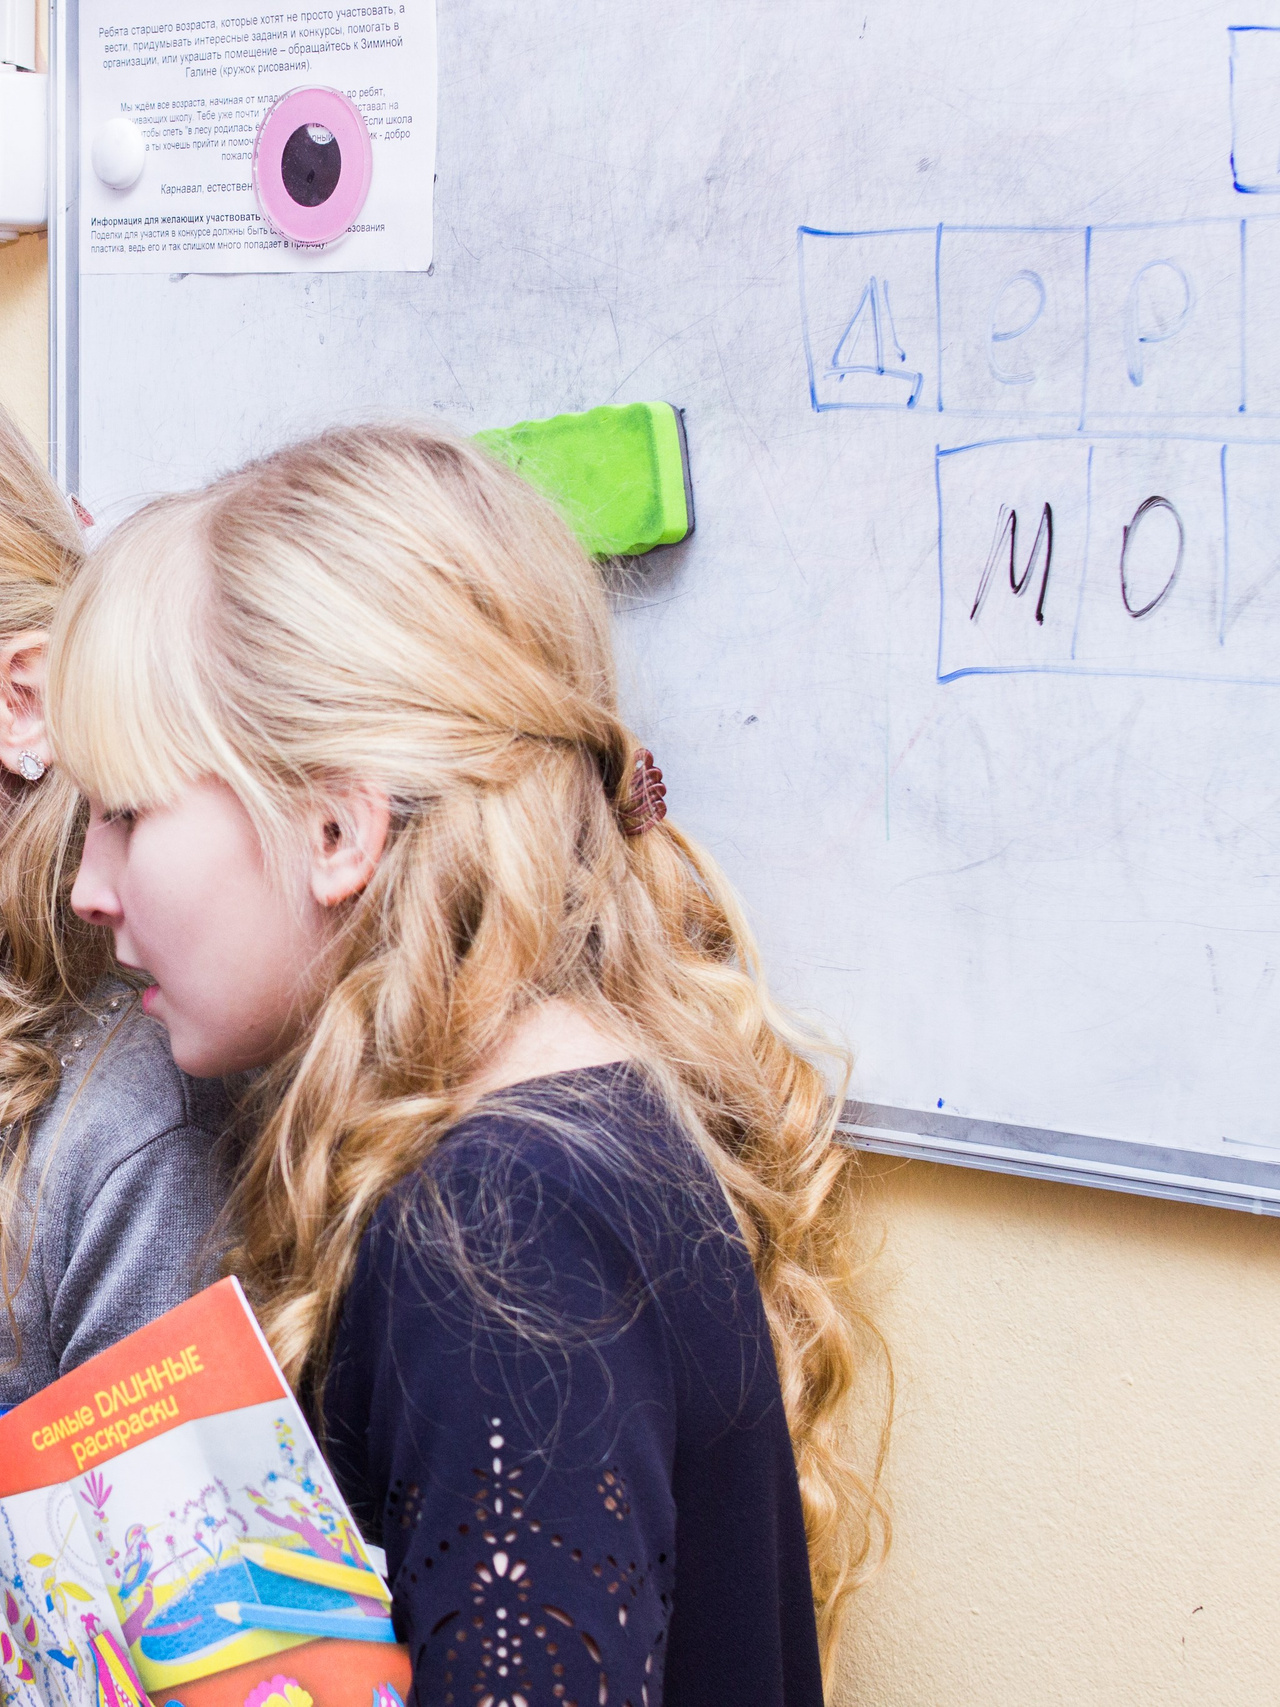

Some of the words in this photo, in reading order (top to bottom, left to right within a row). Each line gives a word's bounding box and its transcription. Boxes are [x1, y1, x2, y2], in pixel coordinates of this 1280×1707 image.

[99, 26, 128, 38] Ребята
[131, 23, 173, 36] старшего
[221, 16, 258, 29] которые
[261, 13, 284, 24] хотят
[287, 12, 298, 22] не
[301, 10, 333, 23] просто
[399, 5, 405, 14] а
[133, 37, 192, 52] придумывать
[194, 33, 249, 47] интересные
[251, 30, 288, 42] задания
[290, 29, 297, 38] и
[348, 22, 391, 35] помогать
[393, 22, 400, 31] в
[162, 54, 178, 64] или
[180, 51, 222, 66] украшать
[224, 47, 277, 60] помещение
[288, 41, 351, 55] обращайтесь
[353, 40, 359, 50] к
[361, 36, 403, 50] Зиминой
[185, 66, 217, 78] Галине
[220, 64, 255, 78] (кружок
[120, 102, 133, 112] Мы
[157, 101, 170, 110] все
[210, 96, 243, 106] начиная
[246, 95, 255, 104] от
[347, 90, 357, 99] до
[197, 110, 215, 121] Тебе
[218, 109, 233, 120] уже
[235, 108, 260, 119] почти
[389, 101, 399, 110] на
[162, 127, 183, 138] спеть
[194, 124, 211, 136] лесу
[214, 122, 253, 134] родилась
[385, 114, 413, 125] школа
[145, 143, 150, 152] а
[152, 142, 161, 151] ты
[163, 139, 191, 151] хочешь
[221, 137, 226, 147] и
[385, 129, 411, 141] добро
[91, 216, 142, 228] Информация
[144, 216, 161, 225] для
[162, 214, 204, 225] желающих
[206, 213, 261, 225] участвовать
[91, 230, 123, 241] Поделки
[124, 230, 138, 240] для
[140, 229, 170, 241] участия
[172, 229, 177, 238] в
[178, 228, 211, 240] конкурсе
[213, 227, 245, 238] должны
[247, 225, 268, 235] быть
[128, 242, 146, 253] ведь
[147, 242, 160, 253] его
[162, 242, 167, 251] и
[169, 242, 181, 251] так
[183, 240, 215, 251] слишком
[217, 240, 242, 250] много
[244, 239, 282, 251] попадает
[284, 239, 289, 248] в
[31, 1405, 95, 1451] самые
[71, 1394, 180, 1471] раскраски
